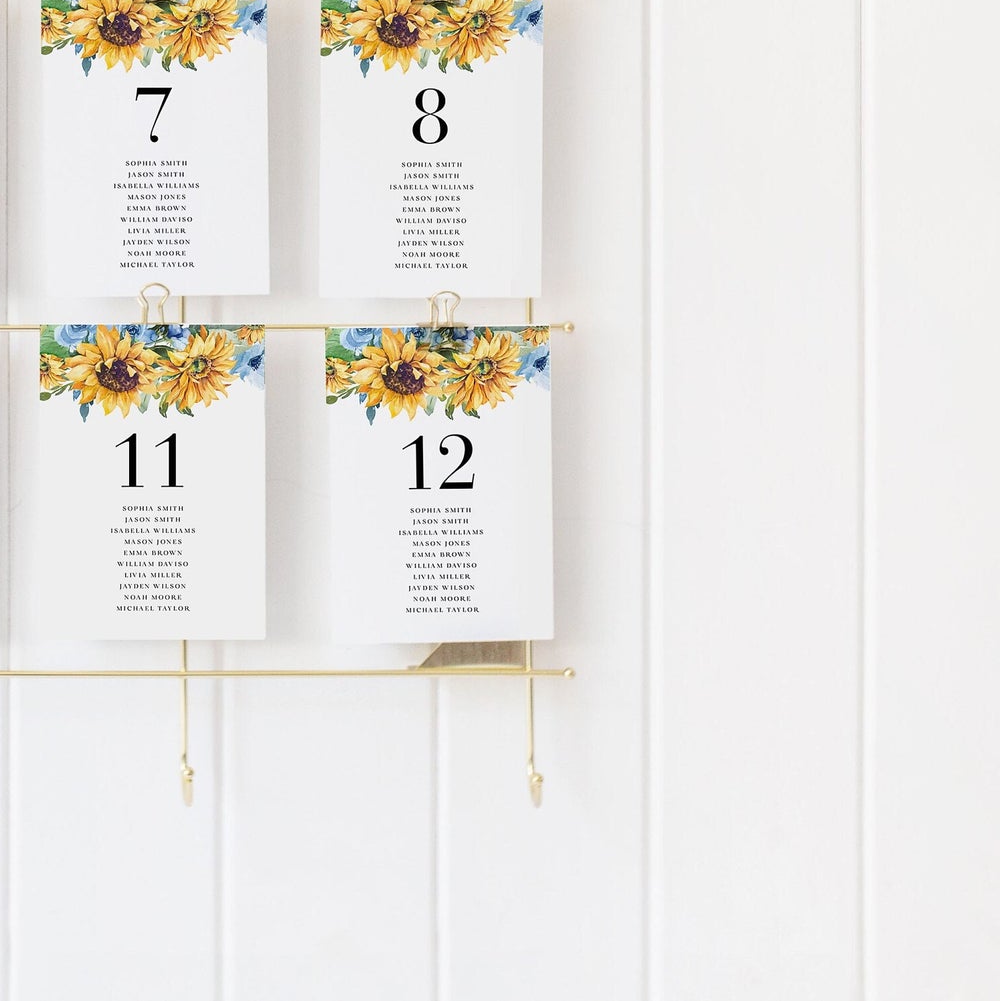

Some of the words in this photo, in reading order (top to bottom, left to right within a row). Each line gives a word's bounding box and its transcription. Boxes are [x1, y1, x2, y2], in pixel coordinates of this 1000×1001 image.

[135, 87, 173, 143] 7
[411, 87, 449, 145] 8
[403, 172, 430, 180] JASON
[432, 172, 460, 180] SMITH
[113, 182, 154, 190] ISABELLA
[435, 195, 461, 203] JONES
[397, 240, 428, 248] JAYDEN
[155, 249, 186, 257] MOORE
[394, 262, 433, 270] MICHAEL
[436, 262, 468, 270] TAYLOR
[115, 432, 184, 488] 11
[402, 433, 476, 490] 12
[124, 516, 151, 524] JASON
[441, 528, 484, 536] WILLIAMS
[156, 538, 183, 546] JONES
[116, 560, 155, 568] WILLIAM
[119, 583, 150, 591] JAYDEN
[405, 606, 444, 614] MICHAEL
